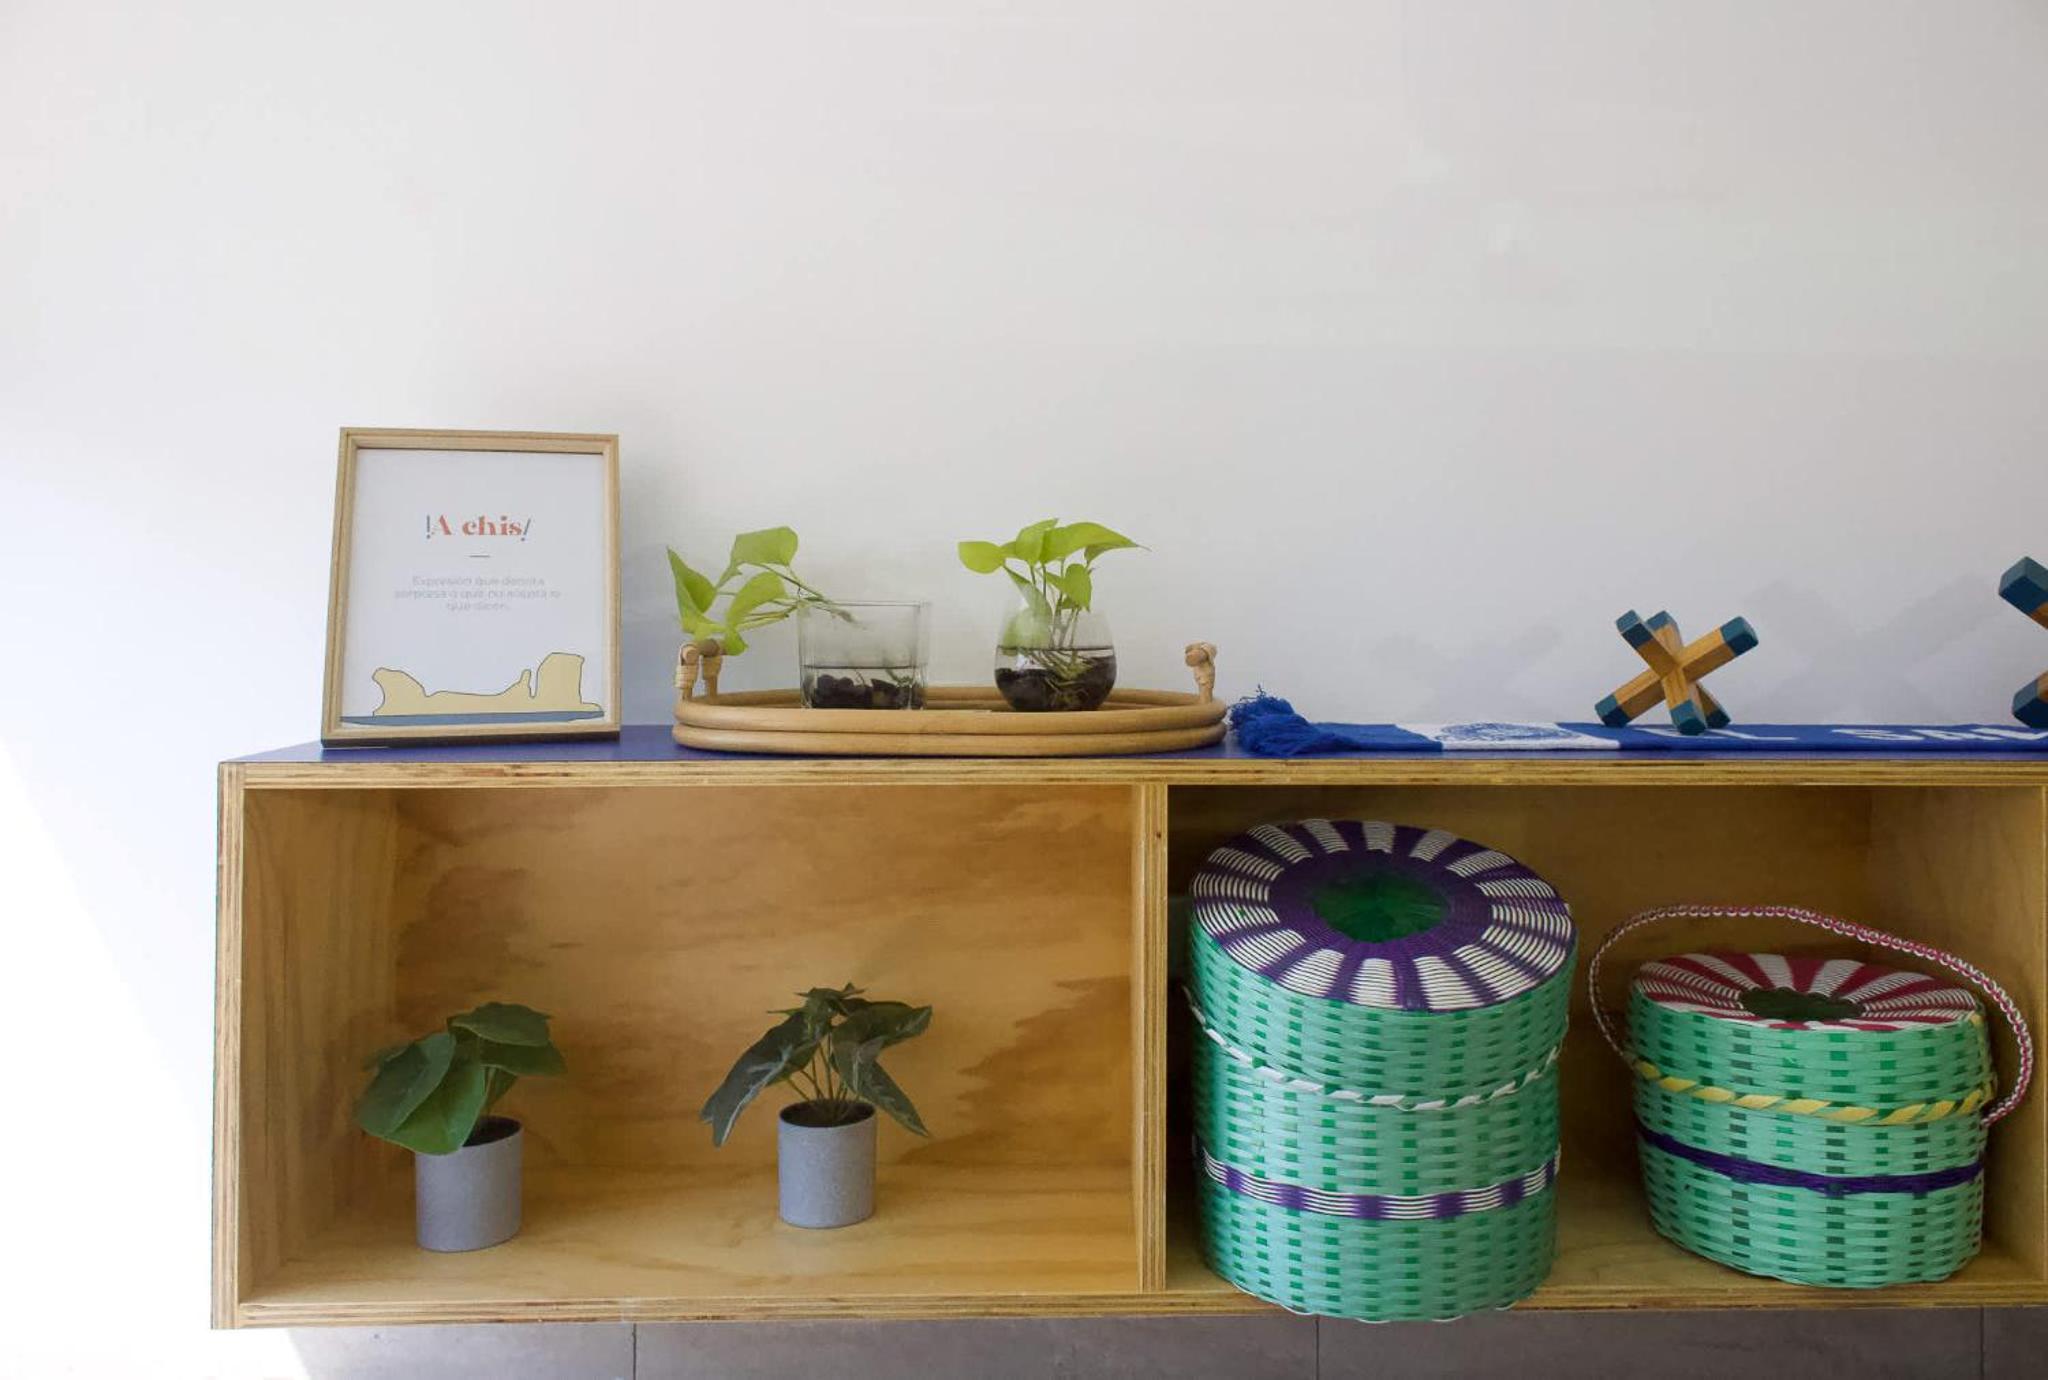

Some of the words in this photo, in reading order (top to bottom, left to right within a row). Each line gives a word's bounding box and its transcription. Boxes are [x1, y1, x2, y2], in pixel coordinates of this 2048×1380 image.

[474, 576, 499, 588] que
[459, 588, 485, 600] que
[445, 601, 472, 612] que
